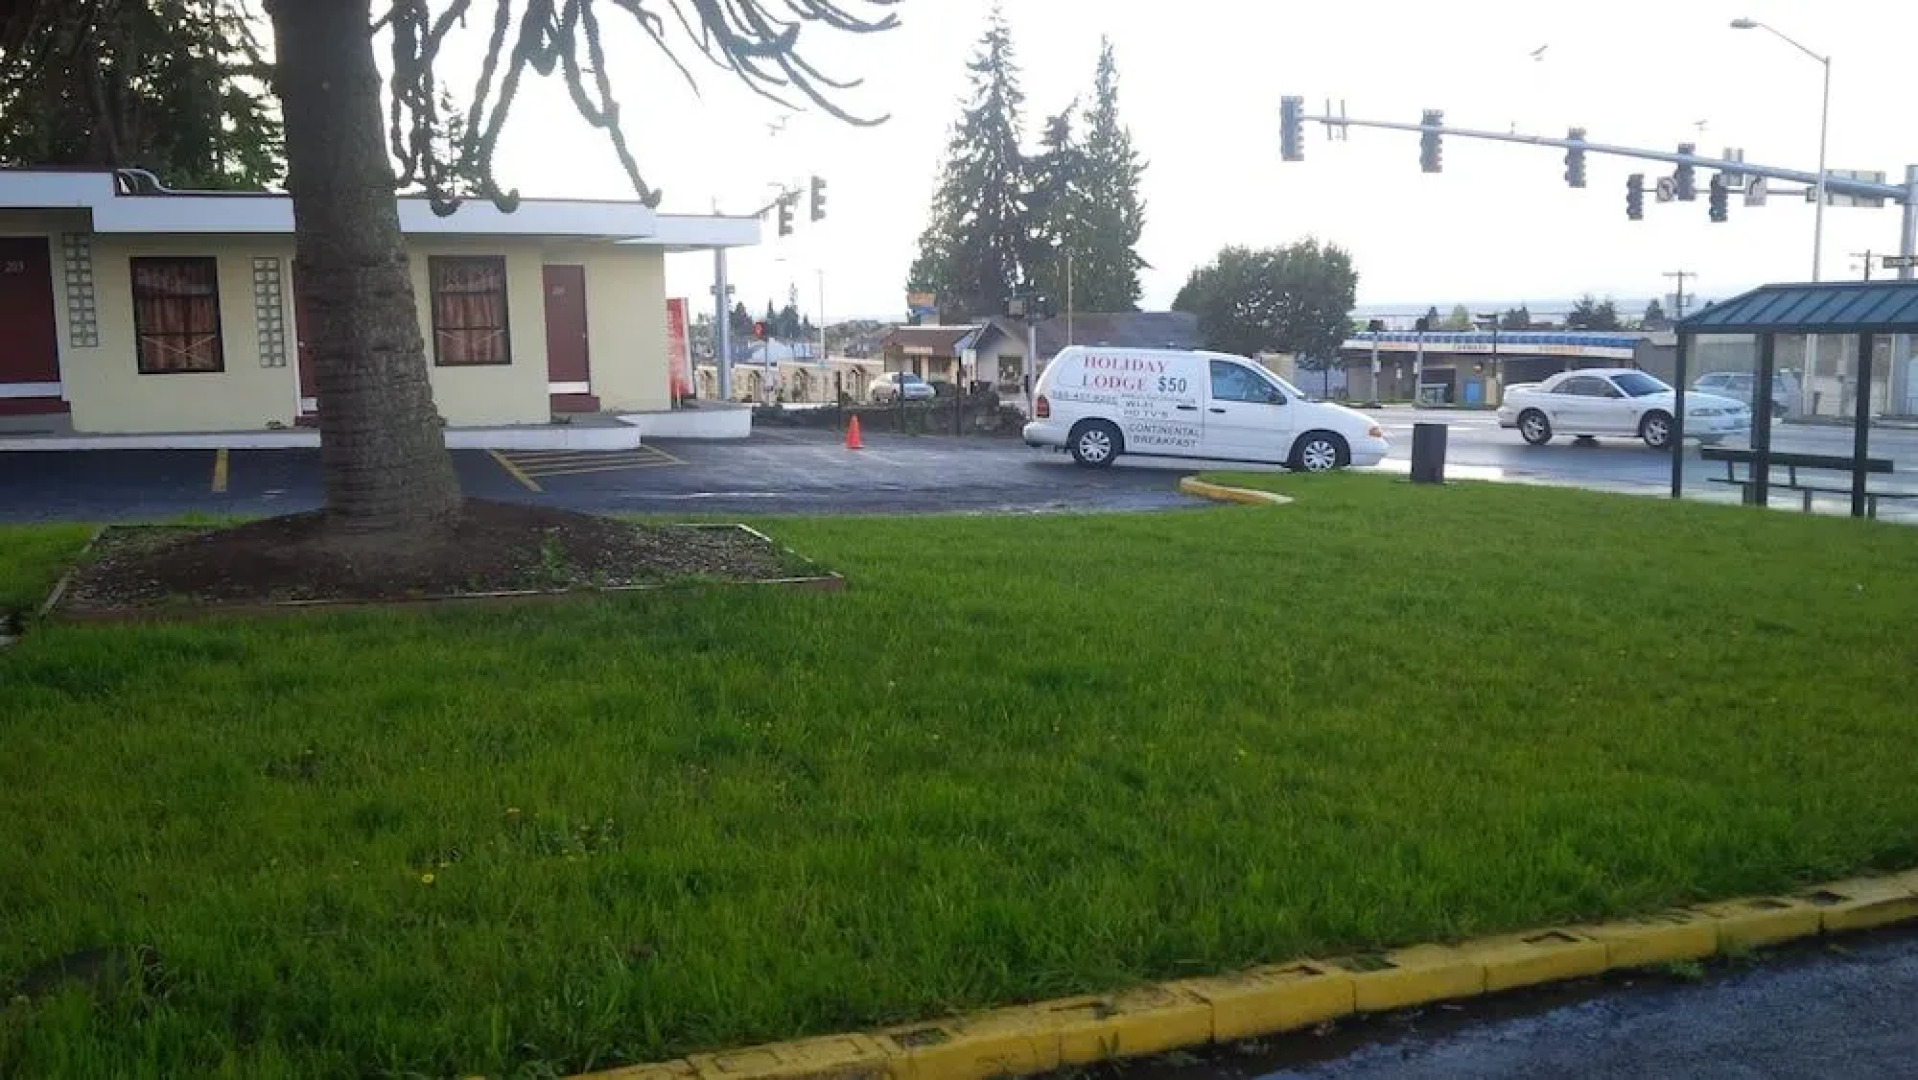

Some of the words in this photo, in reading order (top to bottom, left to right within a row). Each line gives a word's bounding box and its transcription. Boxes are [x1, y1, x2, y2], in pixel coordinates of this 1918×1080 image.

[1084, 354, 1166, 372] HOLIDAY
[1082, 374, 1147, 391] LODGE
[1157, 375, 1187, 393] $50
[1128, 423, 1199, 438] CONTINENTAL
[1133, 435, 1197, 448] BREAKFAST
